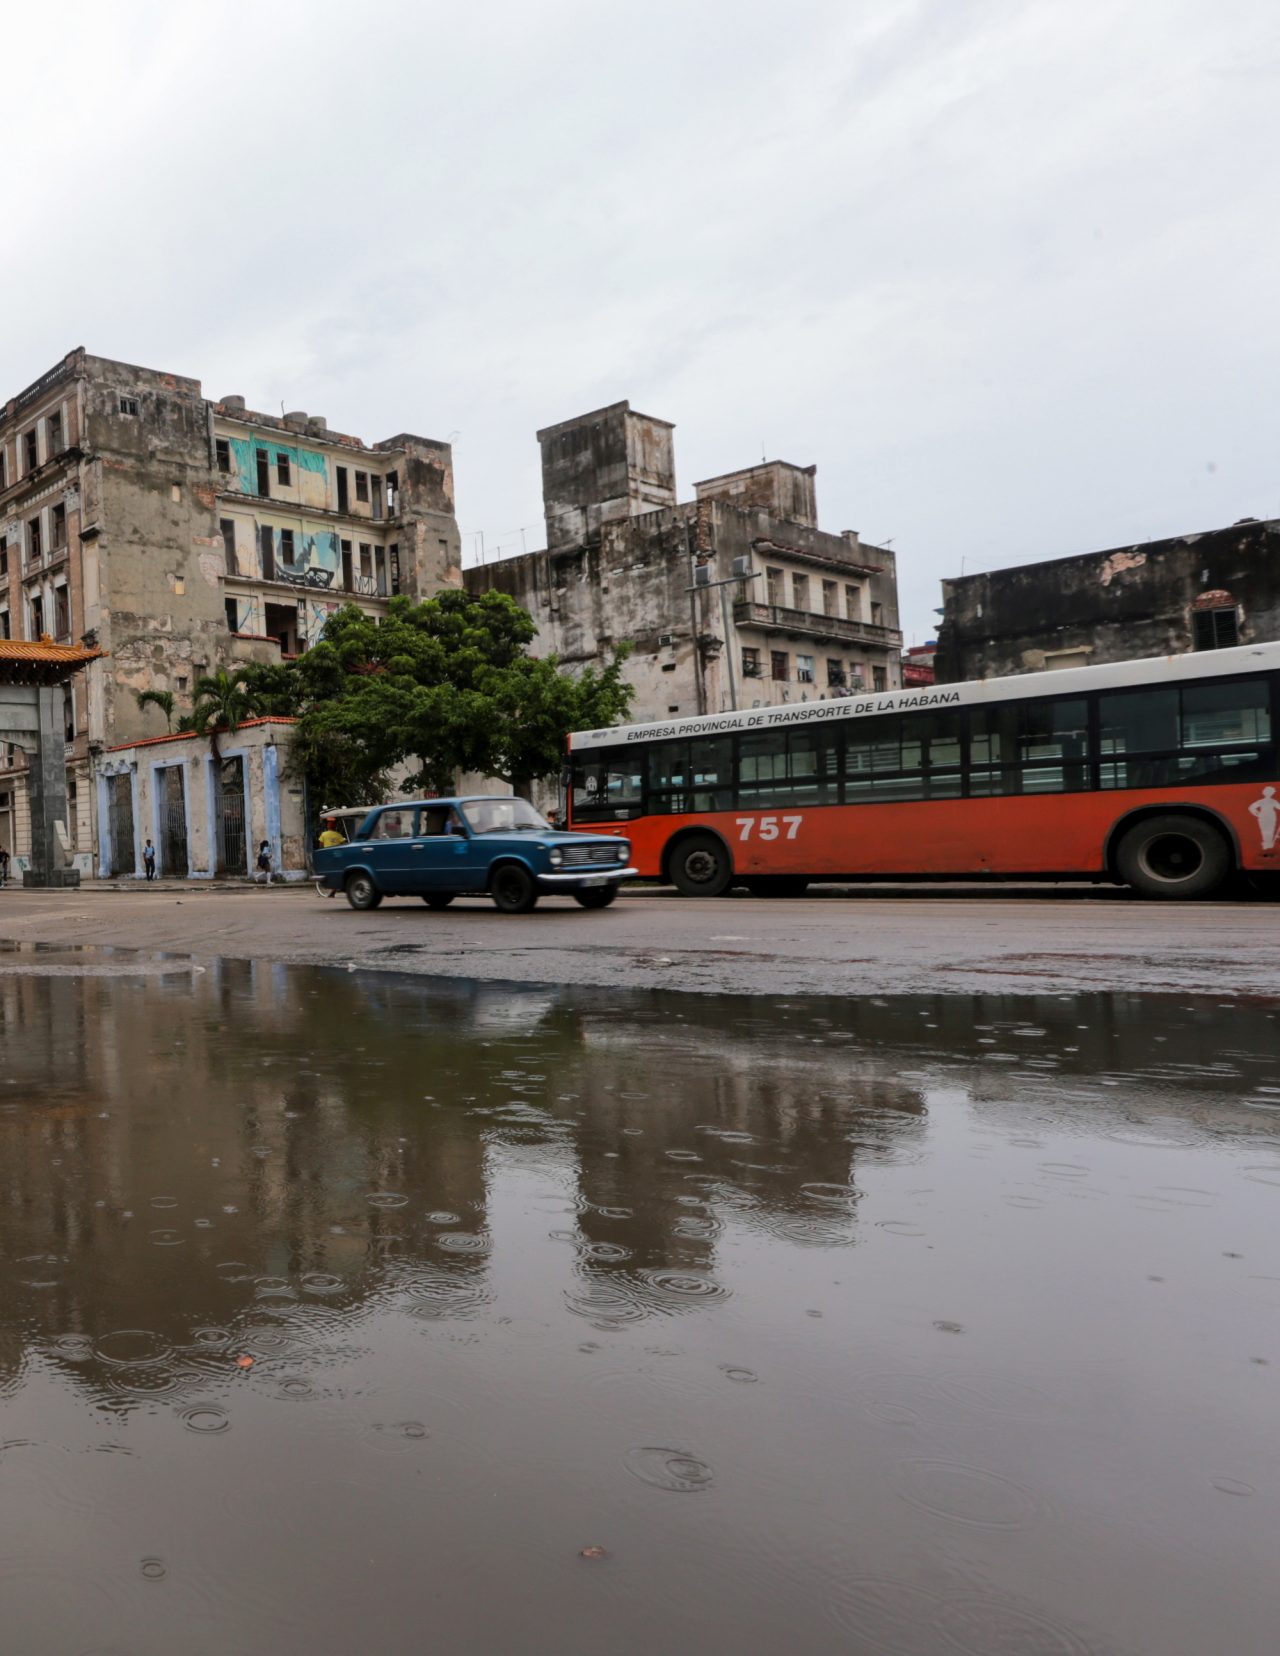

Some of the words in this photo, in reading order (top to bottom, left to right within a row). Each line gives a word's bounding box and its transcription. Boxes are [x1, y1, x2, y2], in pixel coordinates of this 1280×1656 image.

[627, 727, 676, 741] EMPRESA
[678, 719, 744, 735] PROVINCIAL
[747, 715, 764, 727] DE
[767, 705, 852, 724] TRANSPORTE
[854, 702, 874, 714] DE
[877, 699, 895, 712] LA
[898, 692, 961, 709] HABANA
[735, 815, 803, 841] 757
